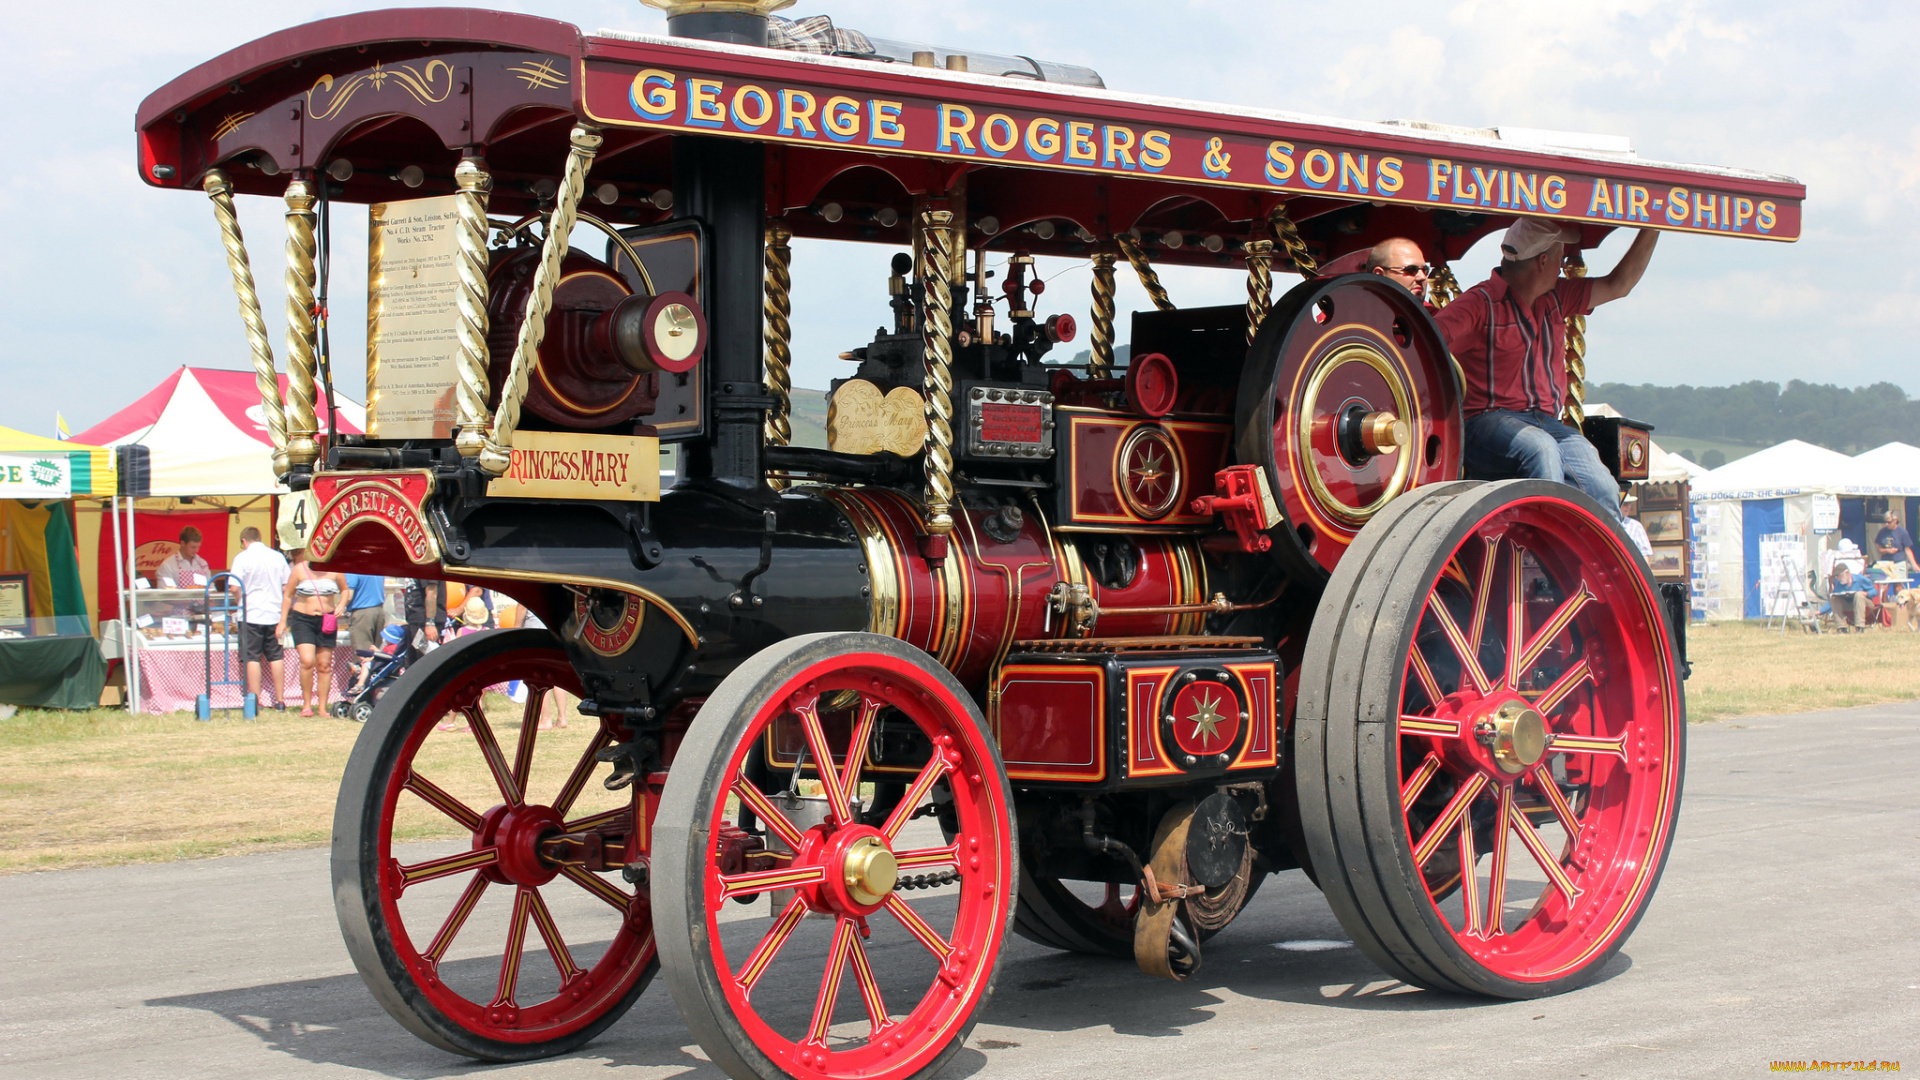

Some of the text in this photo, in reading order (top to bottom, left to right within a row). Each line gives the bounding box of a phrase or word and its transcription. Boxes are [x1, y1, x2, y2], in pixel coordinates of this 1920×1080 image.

[629, 68, 1777, 234] GEORGE ROGERS & SONS FLYING AIR-SHIPS
[510, 449, 630, 488] RINCESS MARY
[1689, 488, 1800, 501] UIDE DOGS FOR THE BLIND
[293, 499, 307, 539] 4
[322, 491, 390, 540] GARRETT
[388, 504, 397, 518] &
[394, 505, 428, 557] SONS
[136, 554, 164, 568] Crust
[592, 602, 639, 649] TRACTOR
